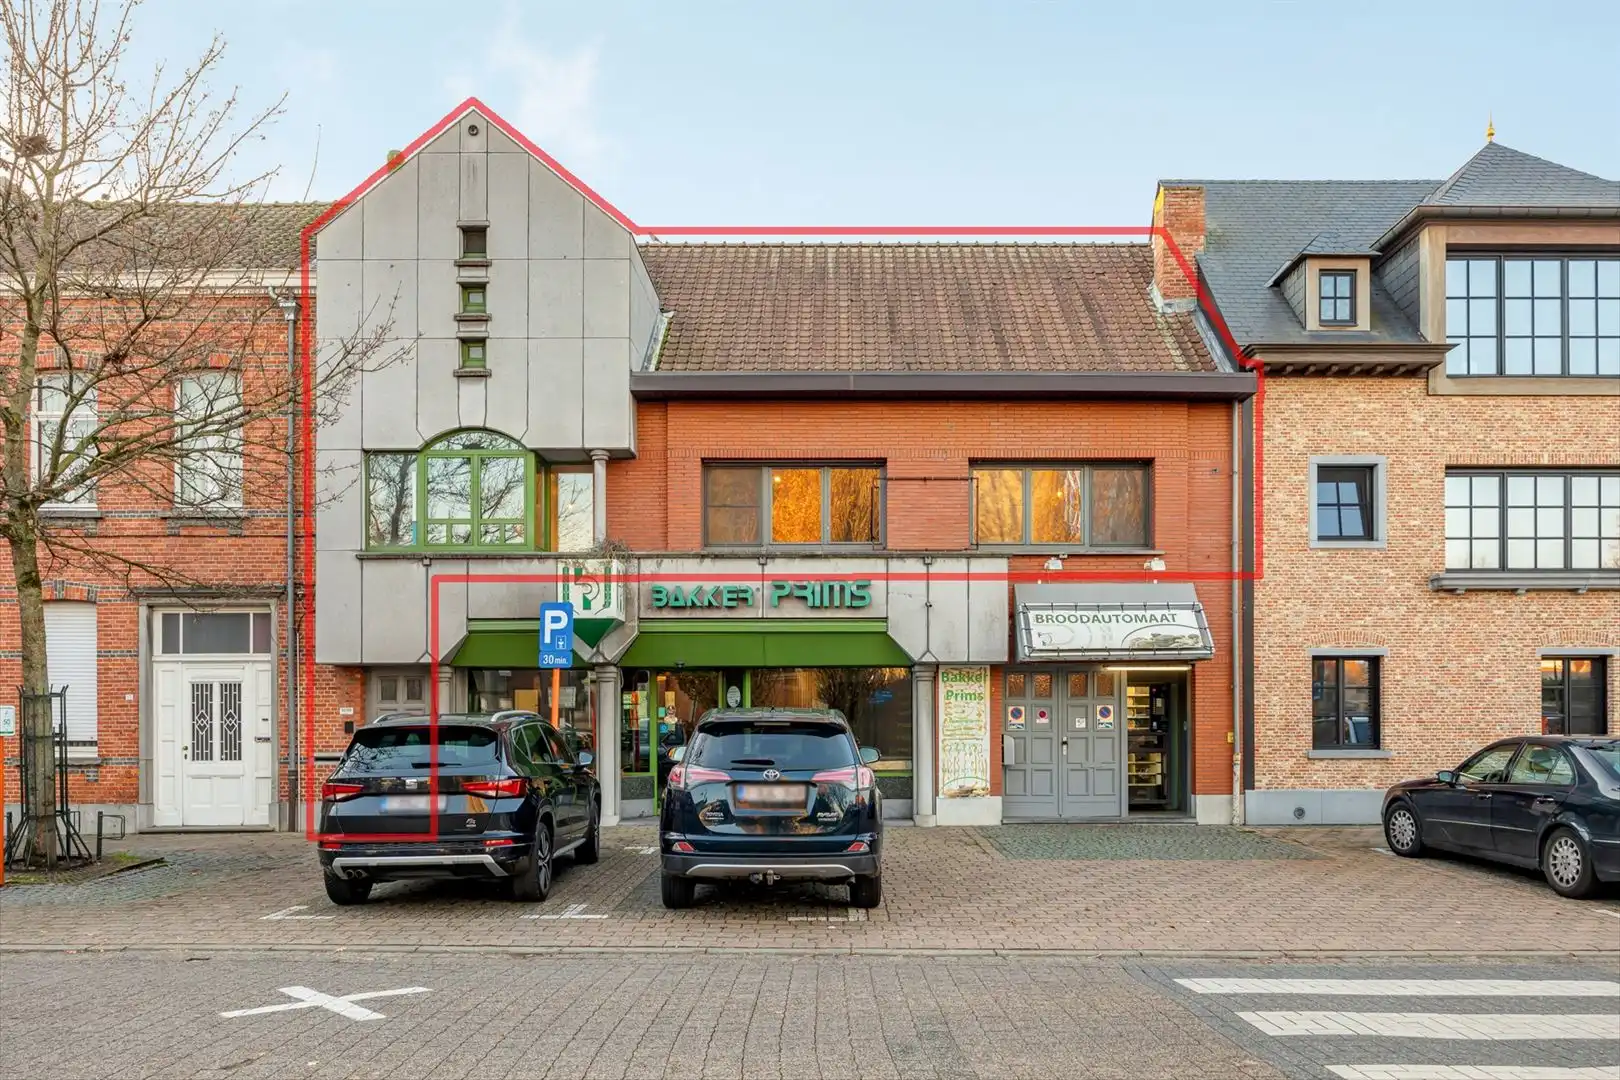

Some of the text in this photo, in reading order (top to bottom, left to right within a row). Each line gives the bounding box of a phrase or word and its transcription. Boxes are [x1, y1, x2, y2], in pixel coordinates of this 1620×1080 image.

[651, 580, 872, 608] BAKKER PRIMS
[1035, 613, 1177, 625] BROODAUTOMAAT
[544, 610, 568, 644] P
[543, 654, 569, 665] 30 min.
[941, 671, 988, 683] Bakker
[946, 689, 984, 701] Prims
